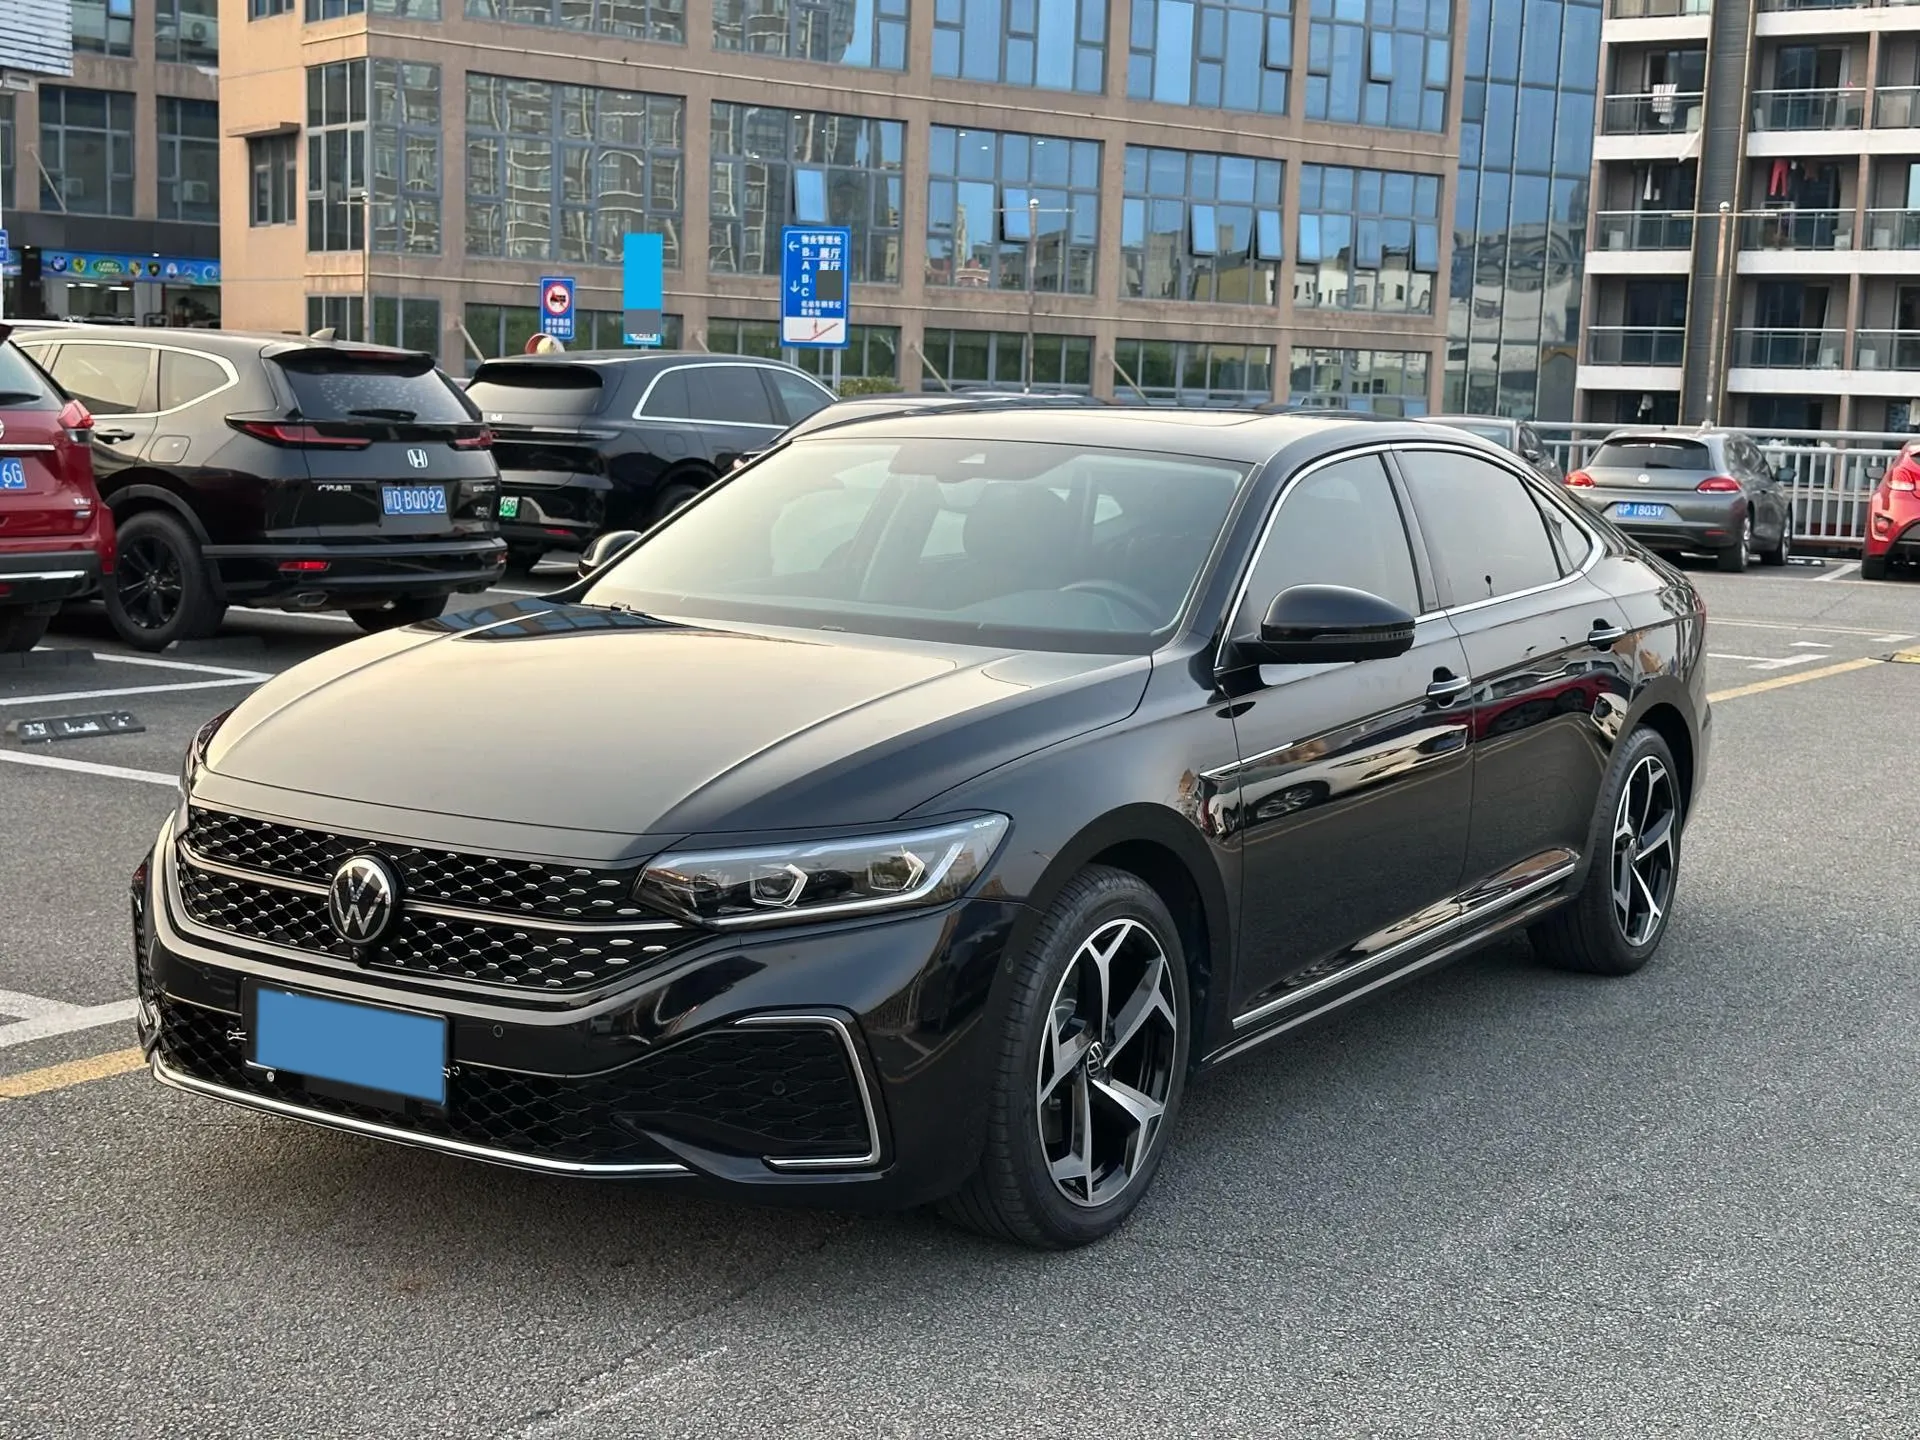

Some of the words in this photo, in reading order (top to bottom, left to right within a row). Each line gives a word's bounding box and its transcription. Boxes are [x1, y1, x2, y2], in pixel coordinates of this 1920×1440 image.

[801, 235, 841, 245] 物业管理处
[802, 261, 810, 270] A
[801, 288, 809, 297] C
[2, 463, 23, 483] 6G
